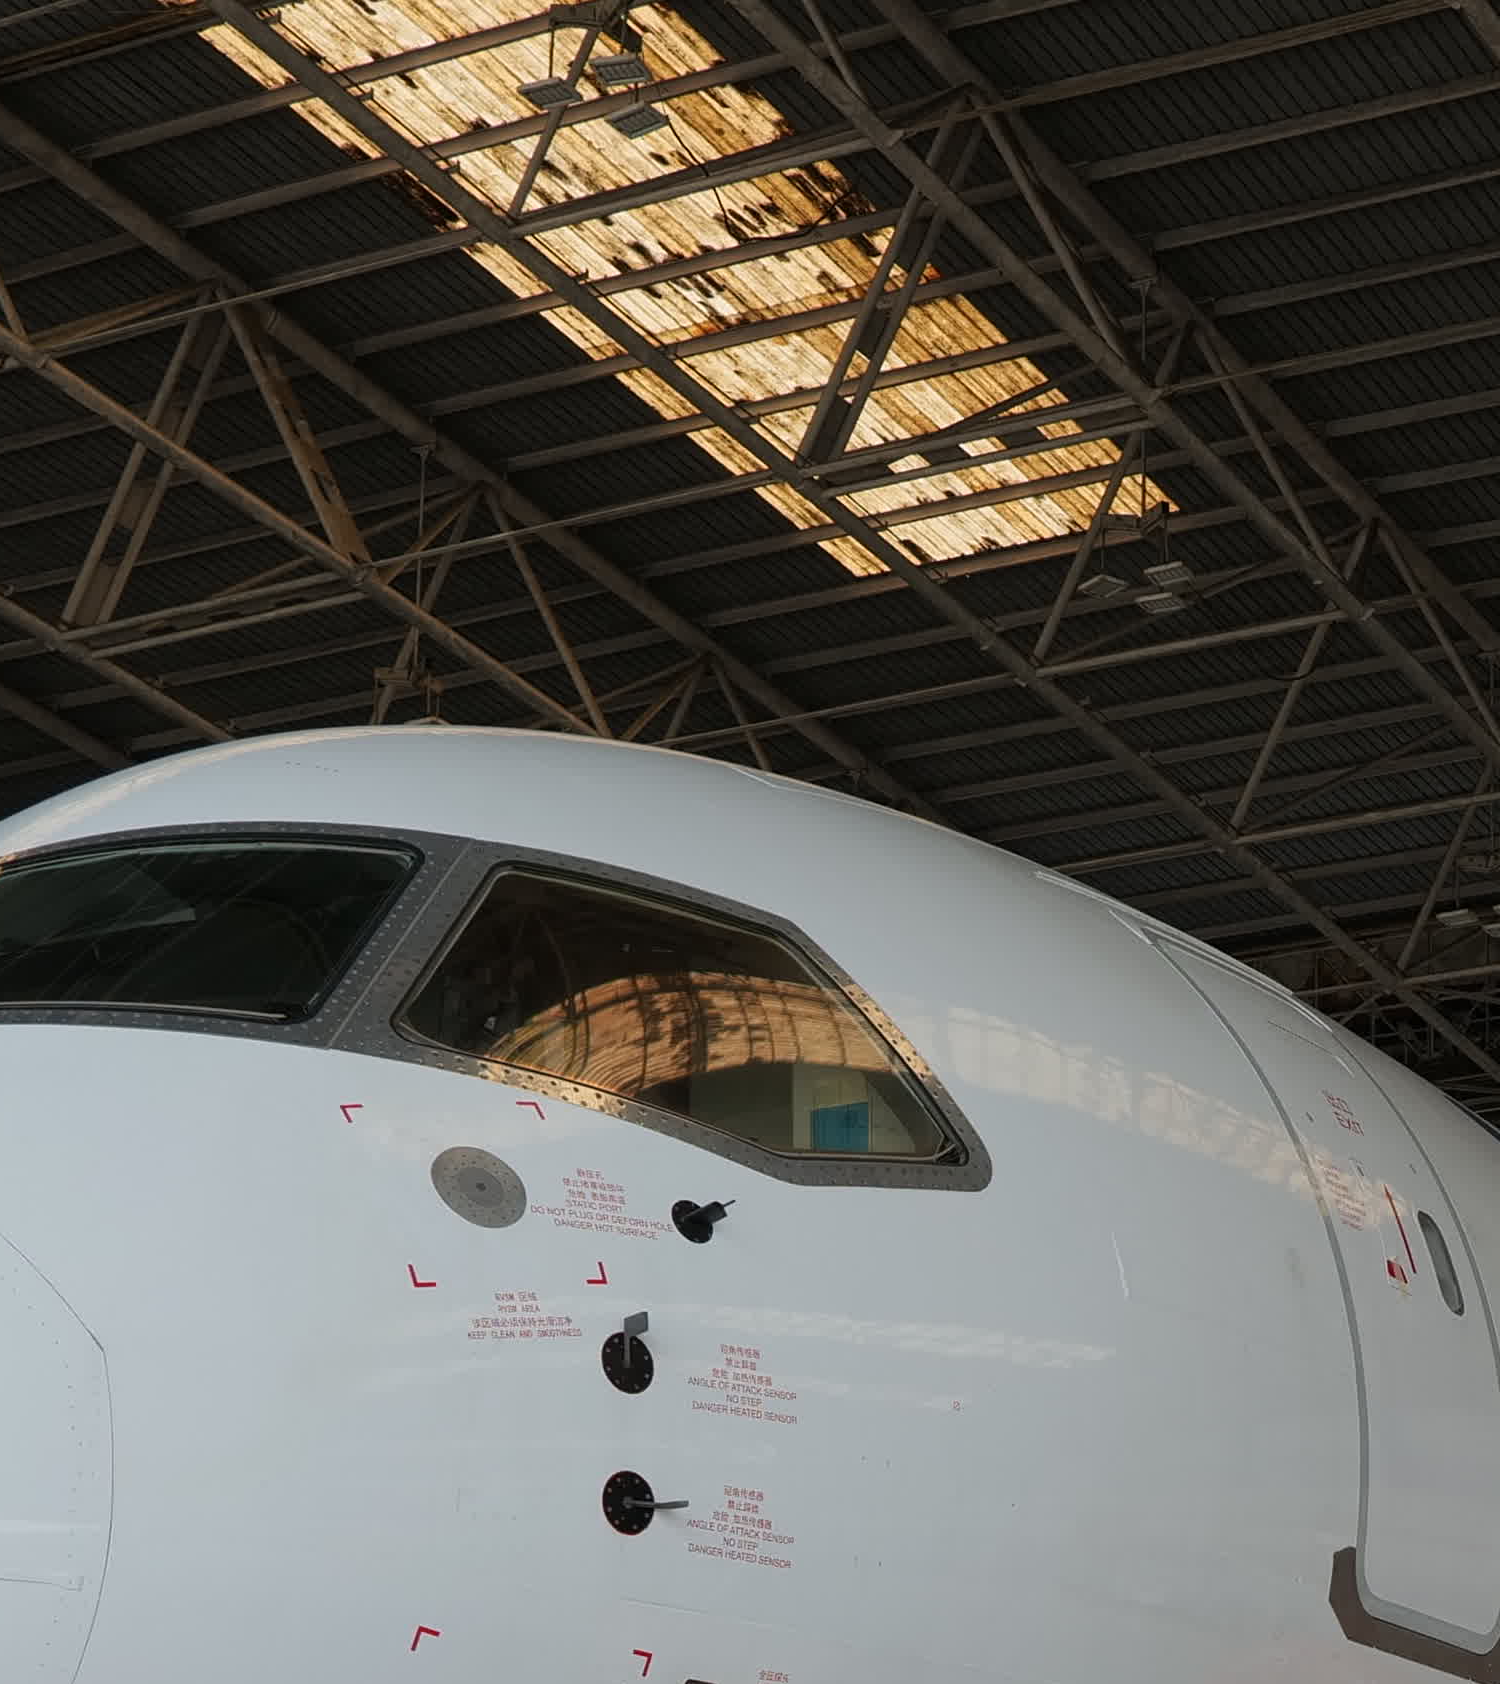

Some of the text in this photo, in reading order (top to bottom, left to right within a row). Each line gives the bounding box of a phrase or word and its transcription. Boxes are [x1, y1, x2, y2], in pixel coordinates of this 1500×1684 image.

[531, 1205, 545, 1214] DO
[547, 1207, 565, 1216] NOT
[568, 1210, 594, 1221] PLUG
[565, 1200, 622, 1213] STATIC PORT
[688, 1376, 796, 1400] ANGLE OF ATTACK SENSOR
[726, 1394, 762, 1407] NO STEP
[692, 1400, 797, 1424] DANGER HEATED SENSOR
[686, 1519, 794, 1544] ANGLE OF ATTACK SENSOR
[723, 1537, 757, 1550] NO STEP
[688, 1543, 791, 1568] DANGER HEATED SENSOR
